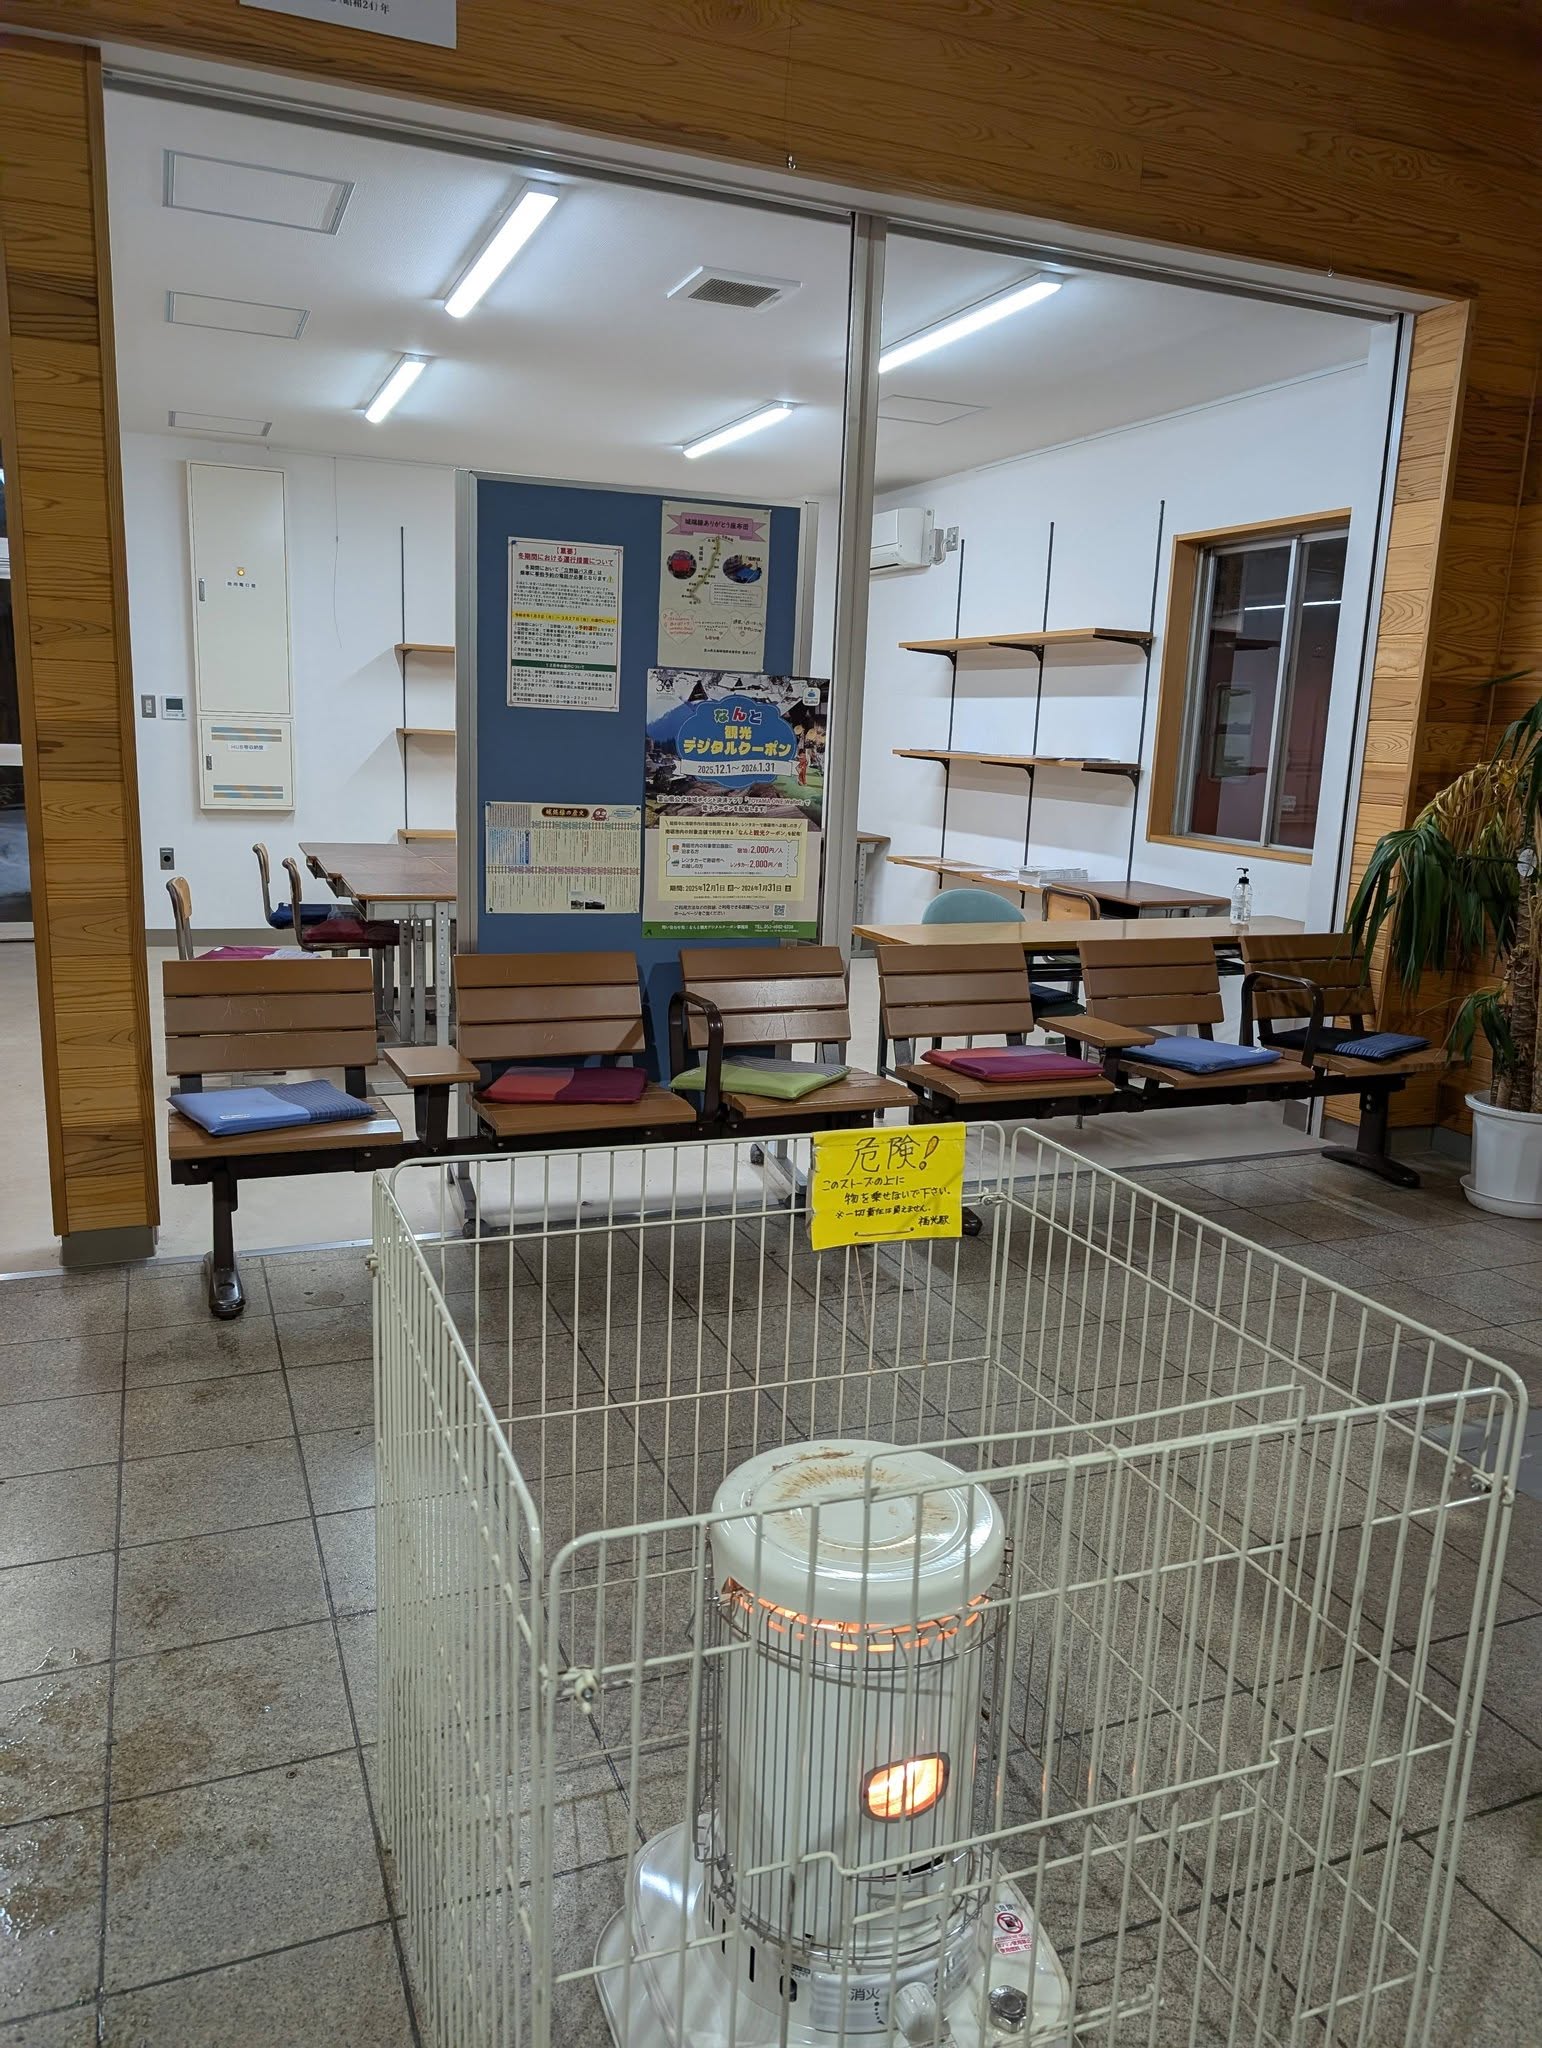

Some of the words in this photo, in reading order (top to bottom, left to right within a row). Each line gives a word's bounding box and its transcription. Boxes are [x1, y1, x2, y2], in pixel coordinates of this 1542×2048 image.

[714, 706, 763, 726] なんと
[725, 725, 752, 741] 観光
[683, 737, 792, 758] デジタルクーポン
[846, 1134, 940, 1175] 危険!
[917, 1215, 951, 1227] 福光駅
[850, 1988, 880, 2002] 消火
